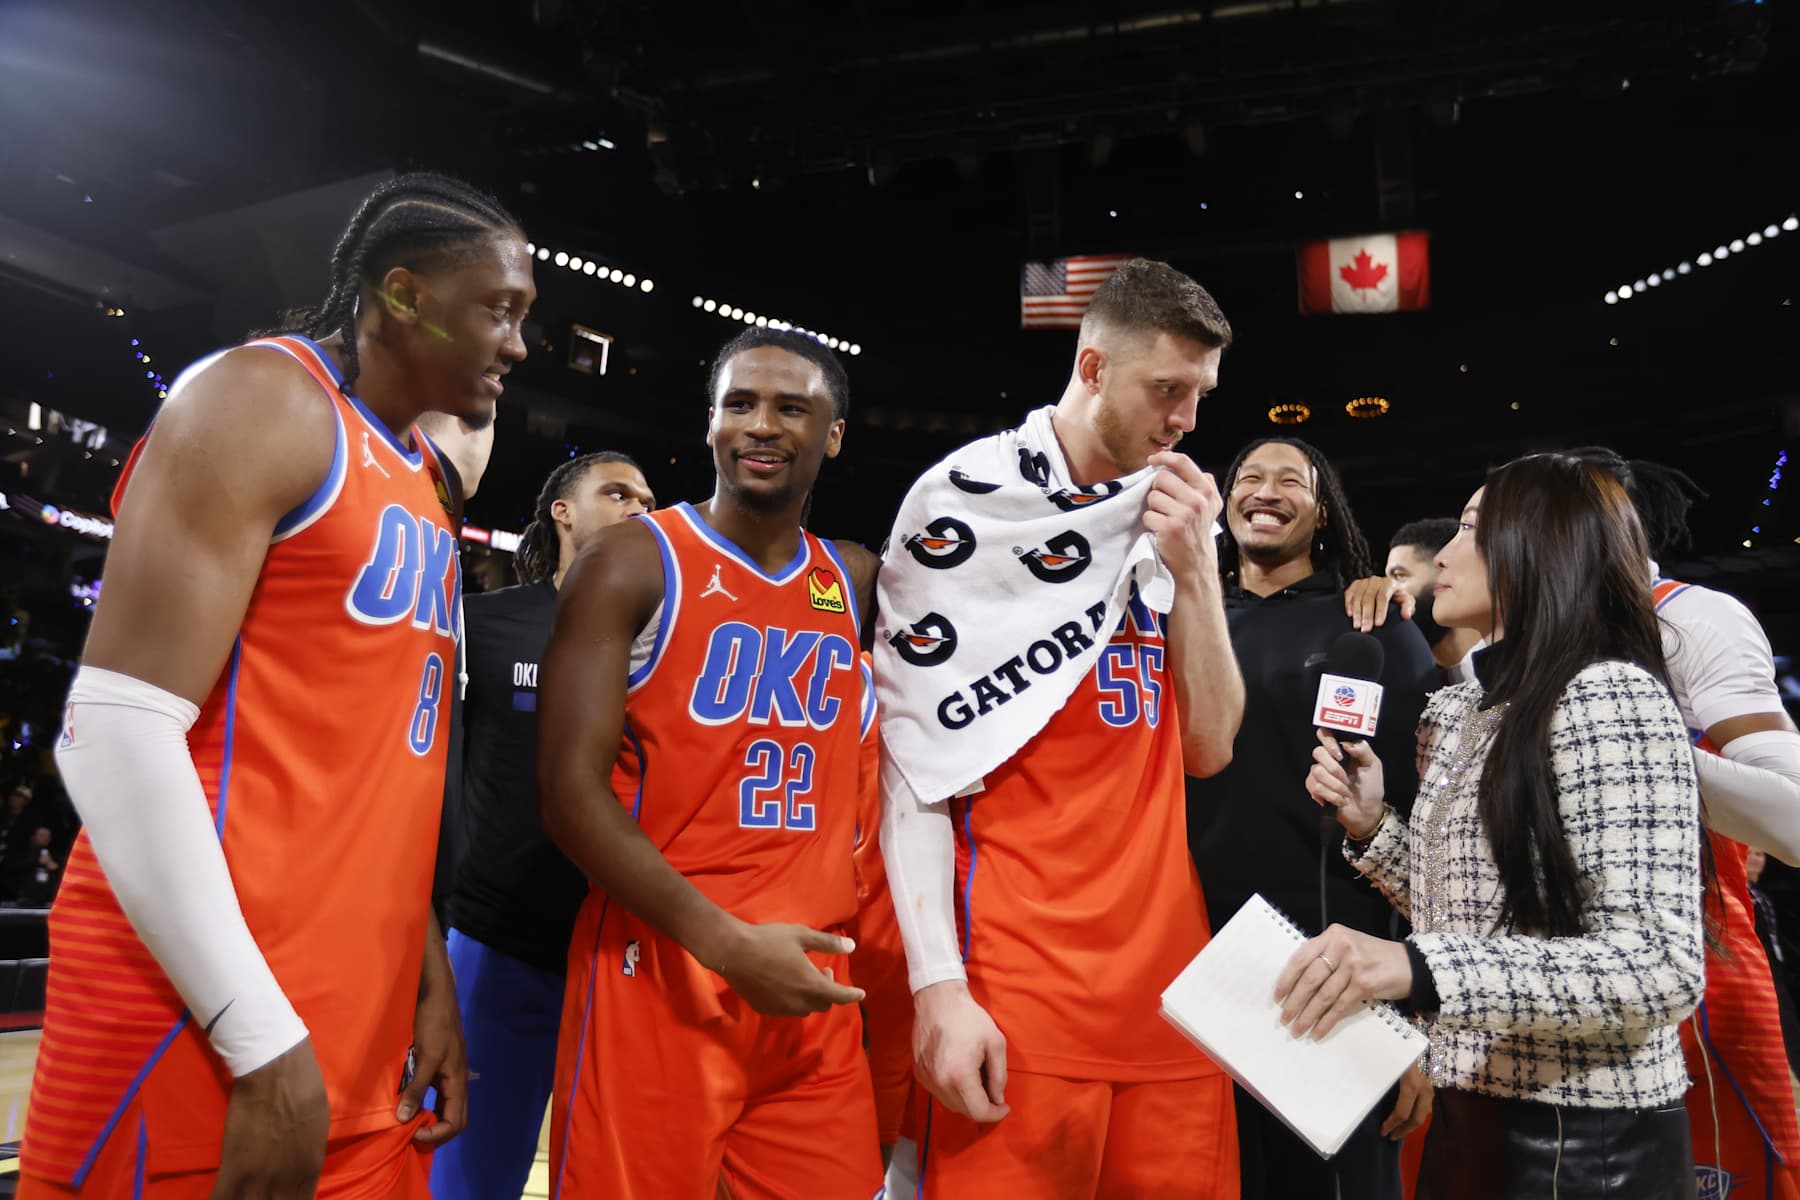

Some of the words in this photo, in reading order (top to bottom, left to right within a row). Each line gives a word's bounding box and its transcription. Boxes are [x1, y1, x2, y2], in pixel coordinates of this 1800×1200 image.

[409, 652, 444, 756] 8
[688, 621, 853, 731] OKC
[1096, 643, 1164, 729] 55
[1324, 711, 1360, 726] ESPN
[738, 738, 816, 831] 22
